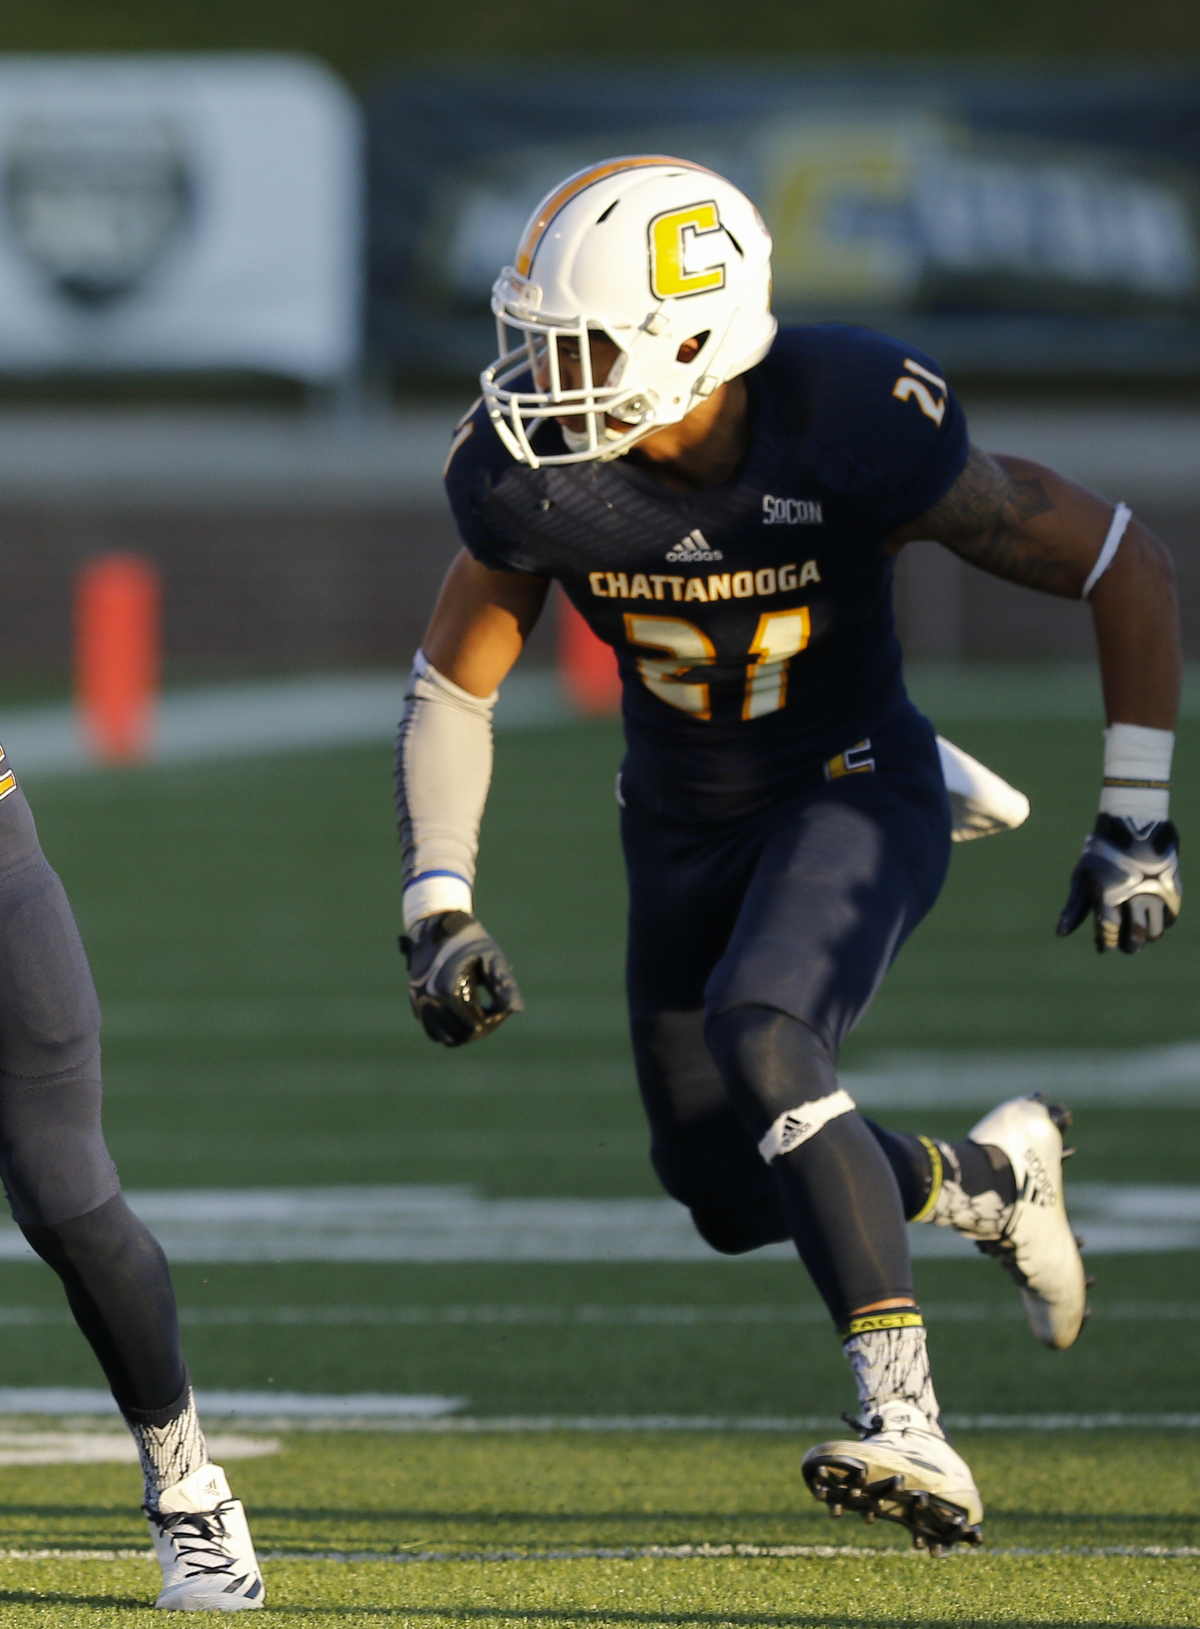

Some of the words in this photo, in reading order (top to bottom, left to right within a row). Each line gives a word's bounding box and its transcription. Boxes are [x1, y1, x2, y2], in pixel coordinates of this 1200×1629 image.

[647, 200, 725, 301] C
[892, 357, 948, 428] 21
[588, 560, 821, 602] CHATTANOOGA
[666, 550, 722, 562] adidas
[623, 606, 811, 721] 21
